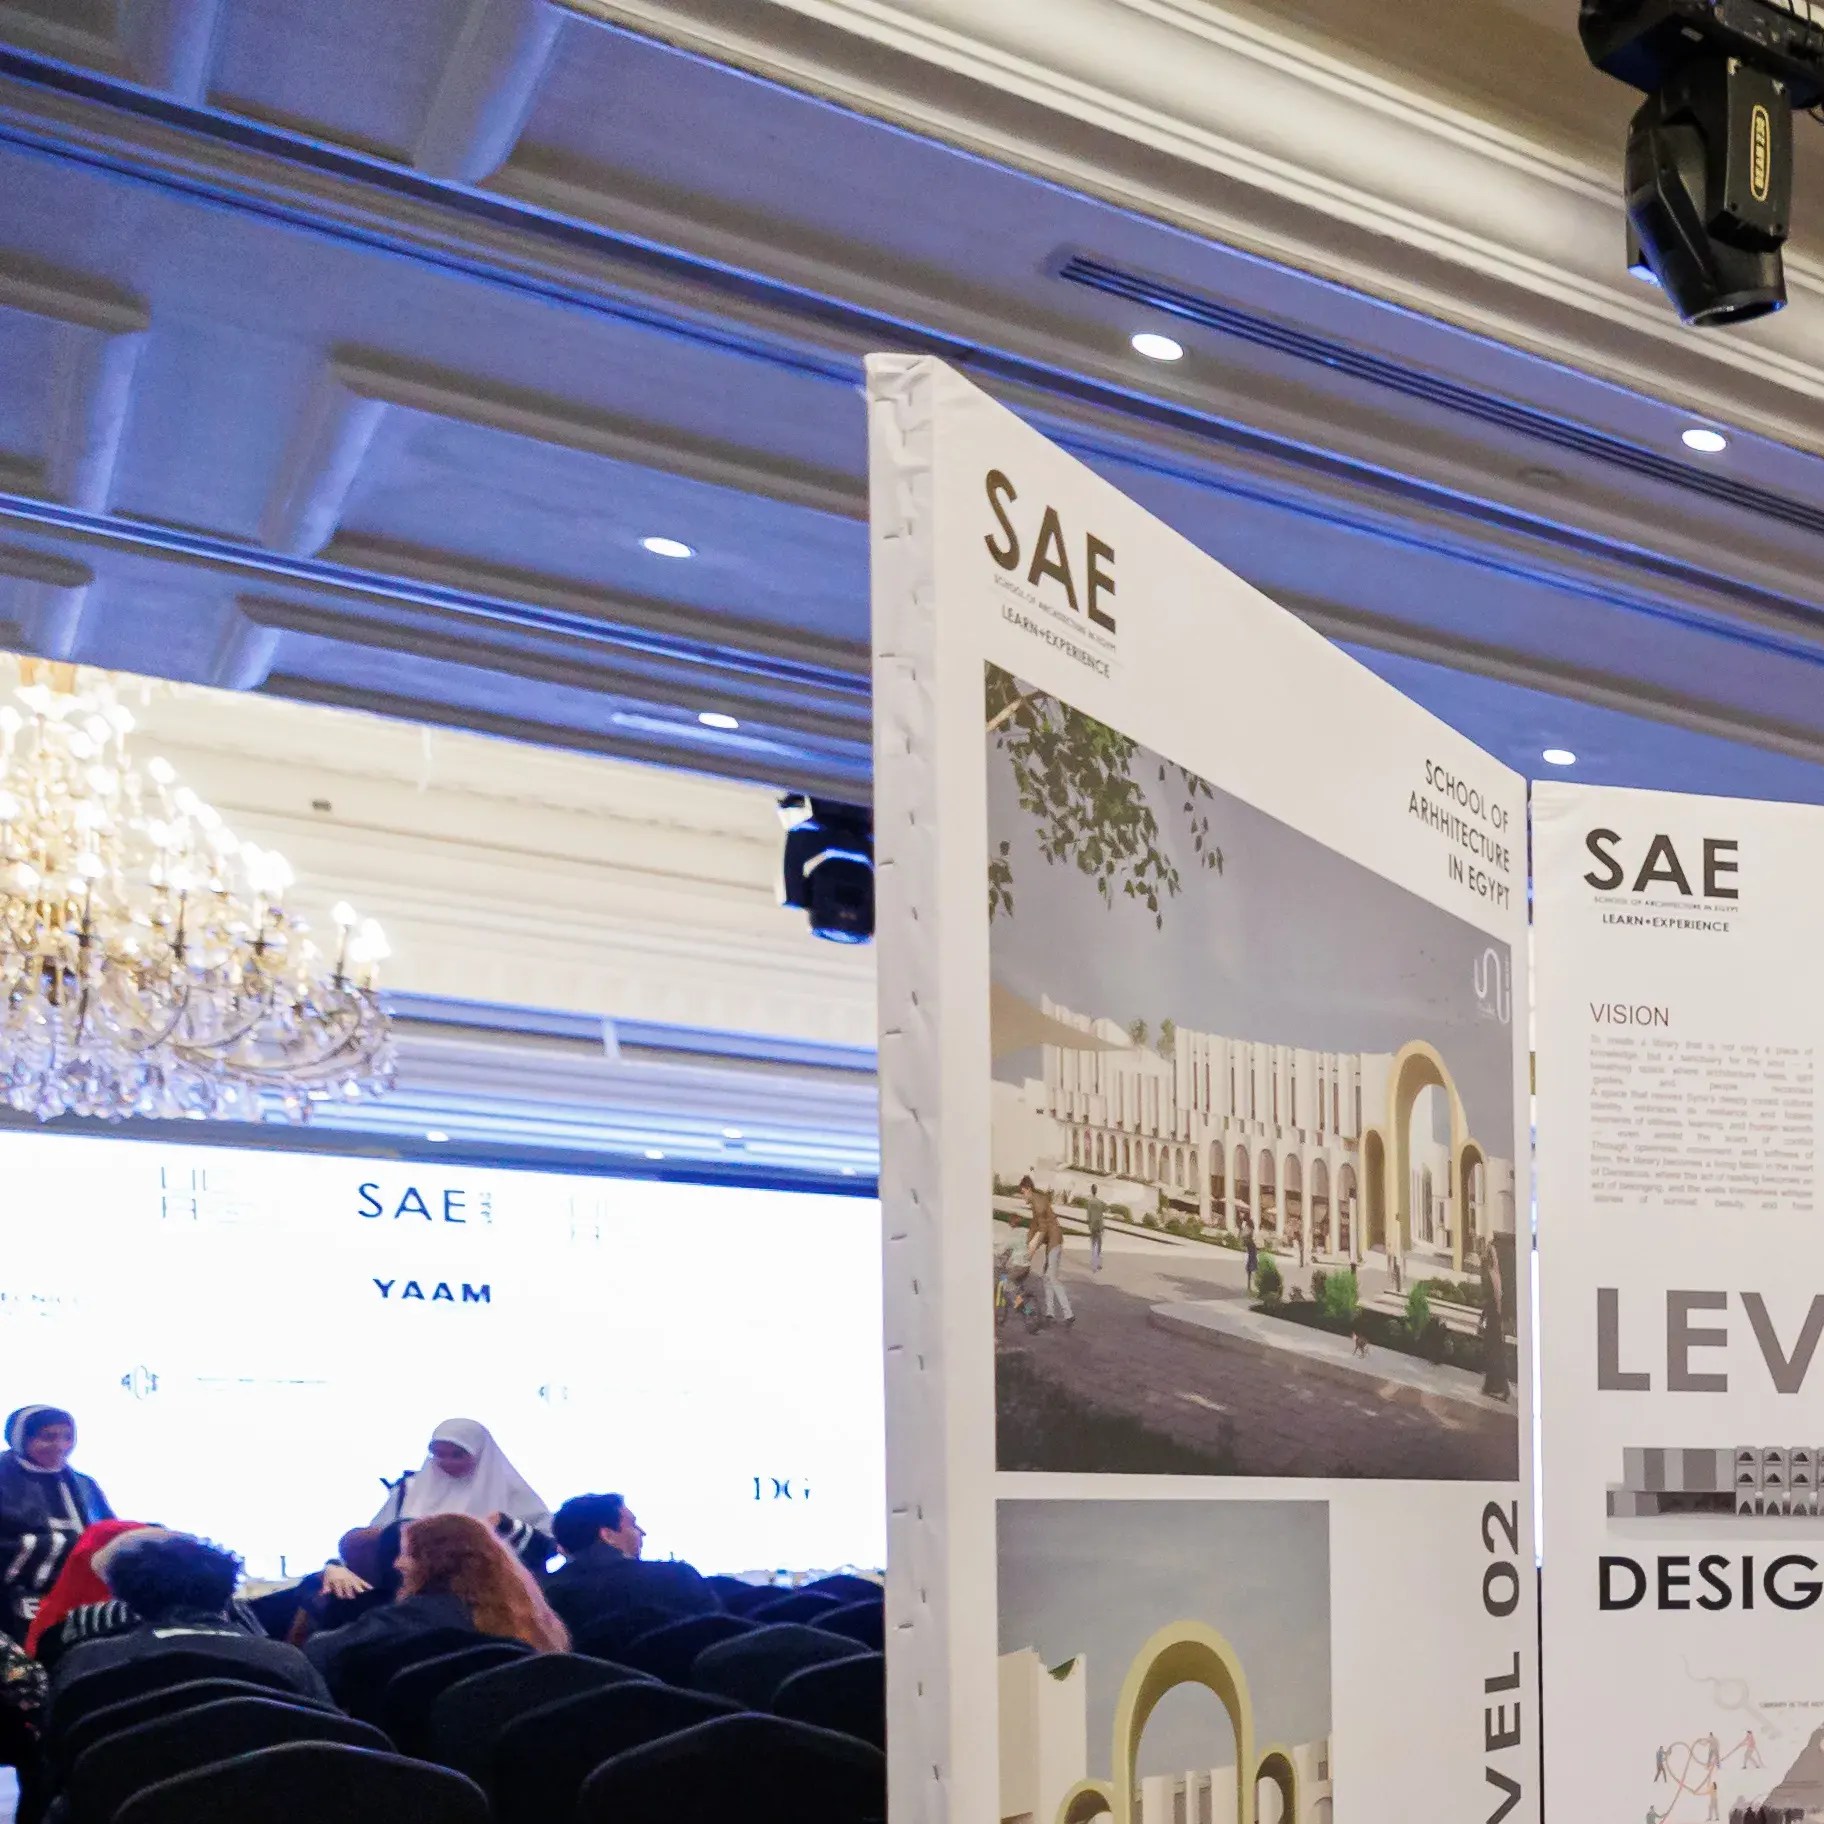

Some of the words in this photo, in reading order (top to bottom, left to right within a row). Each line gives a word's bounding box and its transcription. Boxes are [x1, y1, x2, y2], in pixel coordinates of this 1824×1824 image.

[984, 469, 1116, 635] SAE
[1408, 789, 1510, 873] ARHHITECTURE
[1425, 759, 1487, 820] SCHOOL
[1491, 804, 1509, 834] OF
[1448, 854, 1463, 884] IN
[1468, 864, 1510, 910] EGYPT
[1584, 828, 1739, 899] SAE
[1590, 1002, 1669, 1027] VISION
[358, 1183, 466, 1223] SAE
[373, 1278, 491, 1304] YAAM
[1481, 1499, 1521, 1619] 02
